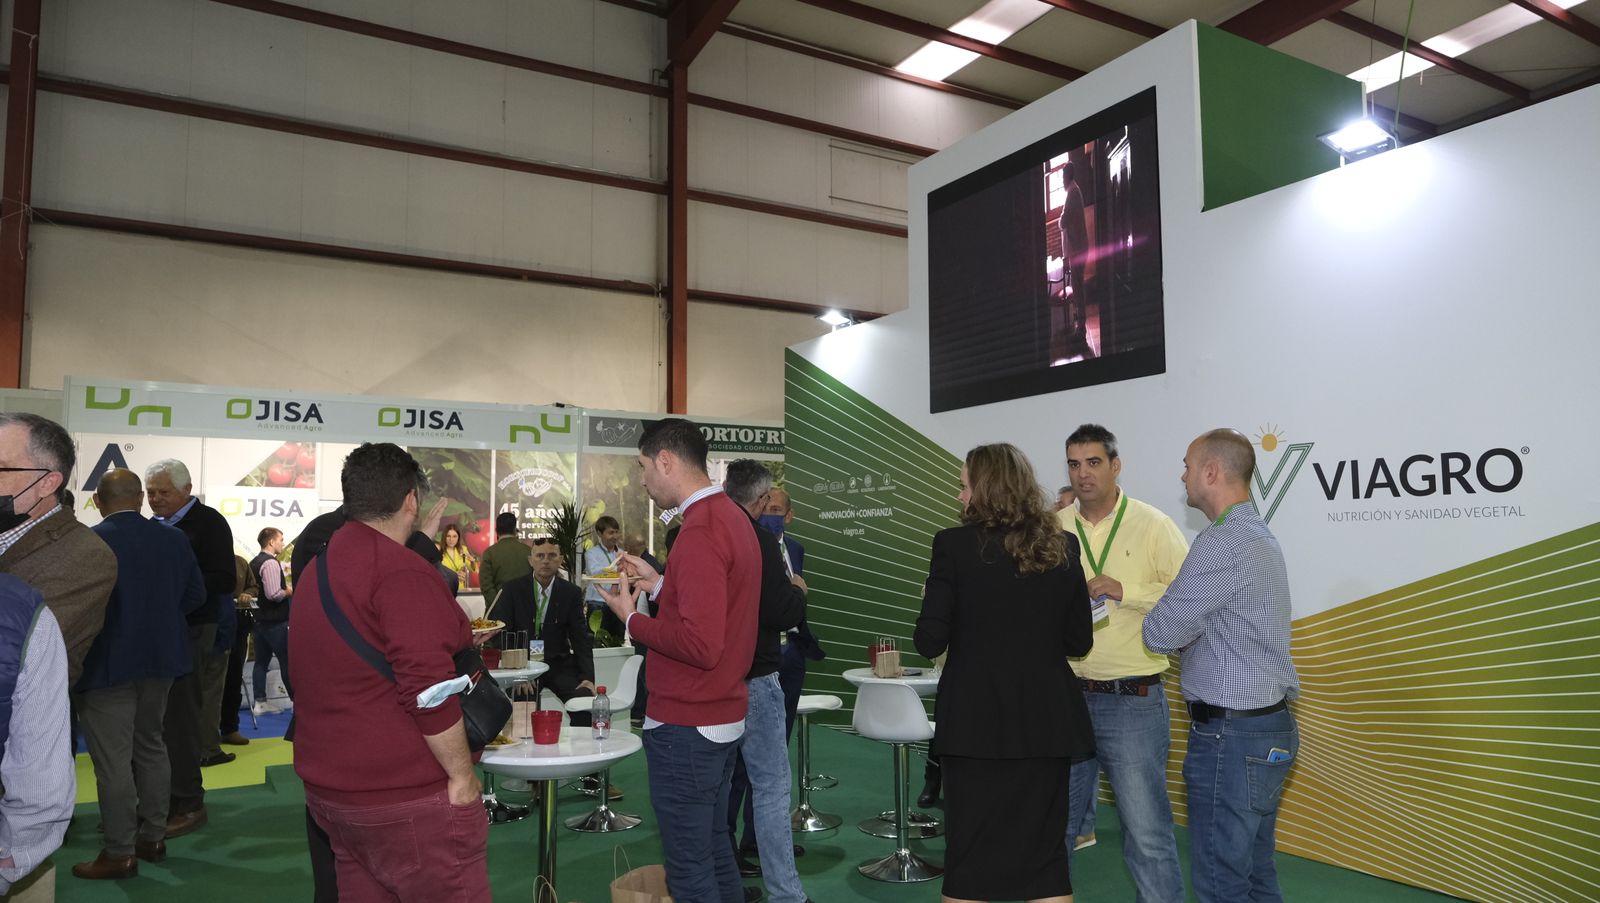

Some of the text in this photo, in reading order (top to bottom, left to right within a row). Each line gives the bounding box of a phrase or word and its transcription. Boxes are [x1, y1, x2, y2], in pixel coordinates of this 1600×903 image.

[257, 422, 302, 431] Advanced
[699, 426, 785, 444] ORTOFR
[1312, 447, 1524, 501] VIAGRO
[1327, 505, 1526, 522] NUTRICIÓN Y SANIDAD VEGETAL
